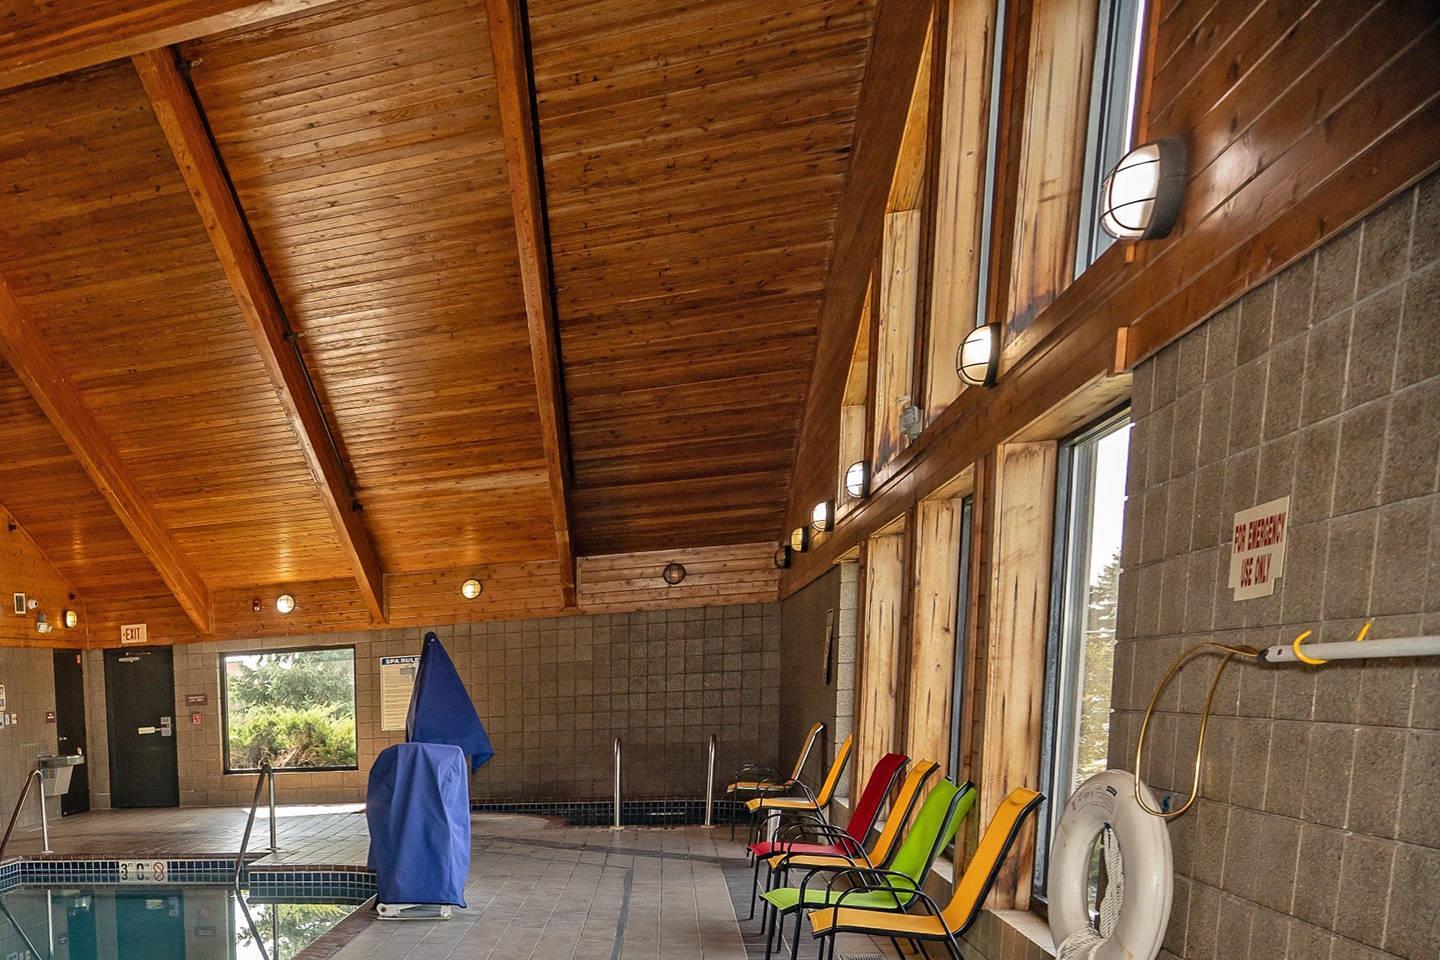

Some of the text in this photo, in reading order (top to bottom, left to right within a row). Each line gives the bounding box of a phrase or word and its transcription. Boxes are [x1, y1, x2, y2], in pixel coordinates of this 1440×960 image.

[1233, 512, 1286, 554] FOR EMERGENCY
[1241, 553, 1272, 588] USE ONLY
[126, 628, 140, 640] EXIT
